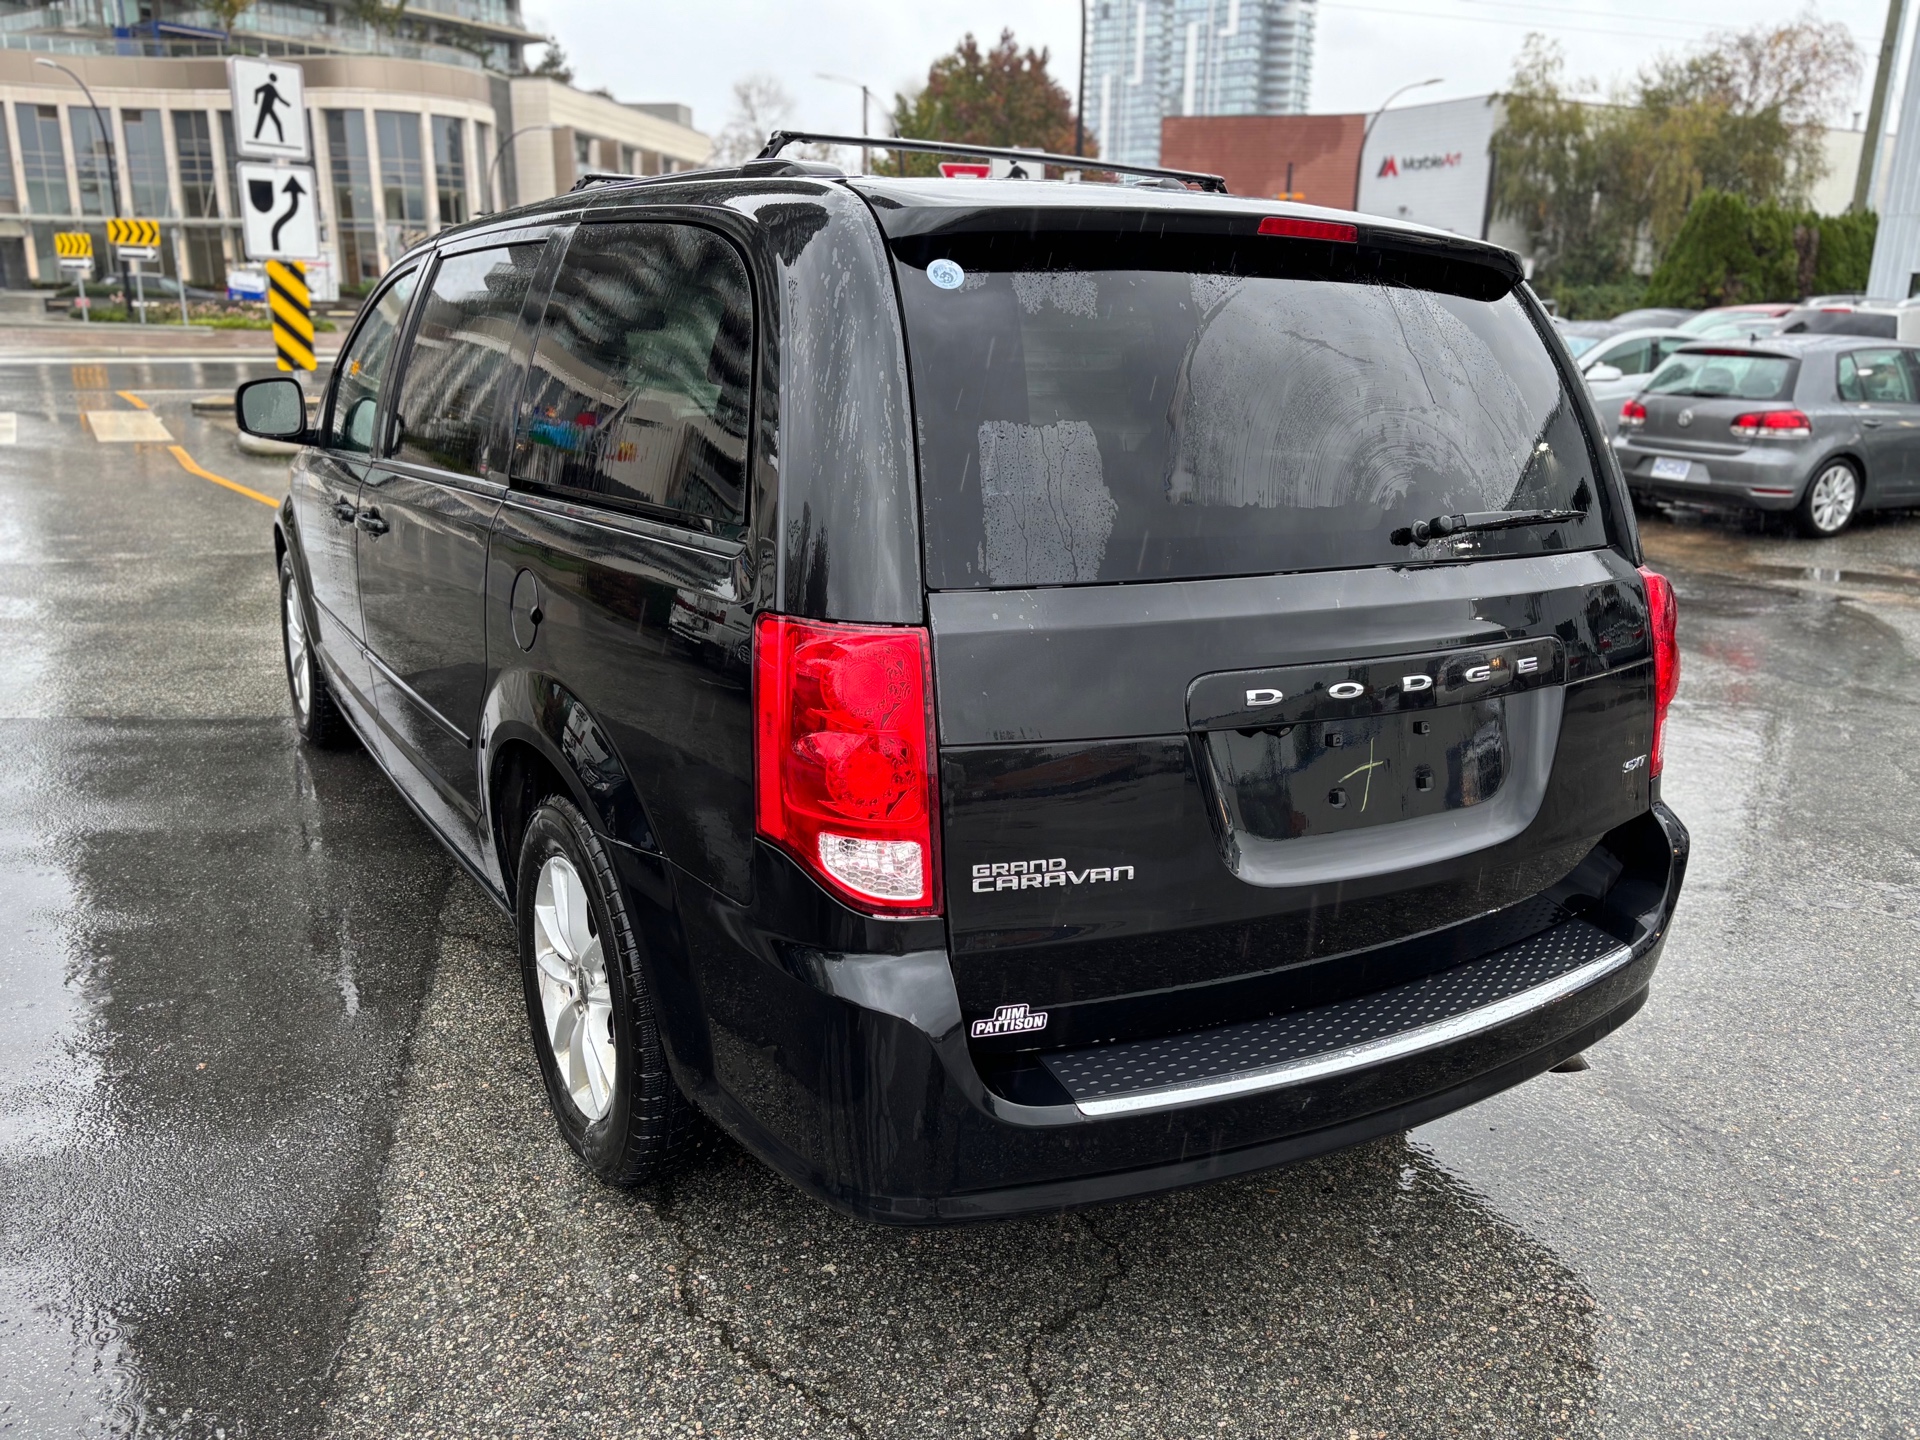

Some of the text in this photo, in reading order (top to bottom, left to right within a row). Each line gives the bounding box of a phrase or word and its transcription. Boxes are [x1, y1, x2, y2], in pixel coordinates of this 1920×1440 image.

[1246, 656, 1538, 706] DODGE
[1622, 754, 1647, 773] SXT
[972, 857, 1067, 877] GRAND
[972, 865, 1135, 893] CARAVAN
[997, 1006, 1025, 1021] JIM
[975, 1015, 1044, 1035] PATTISON
